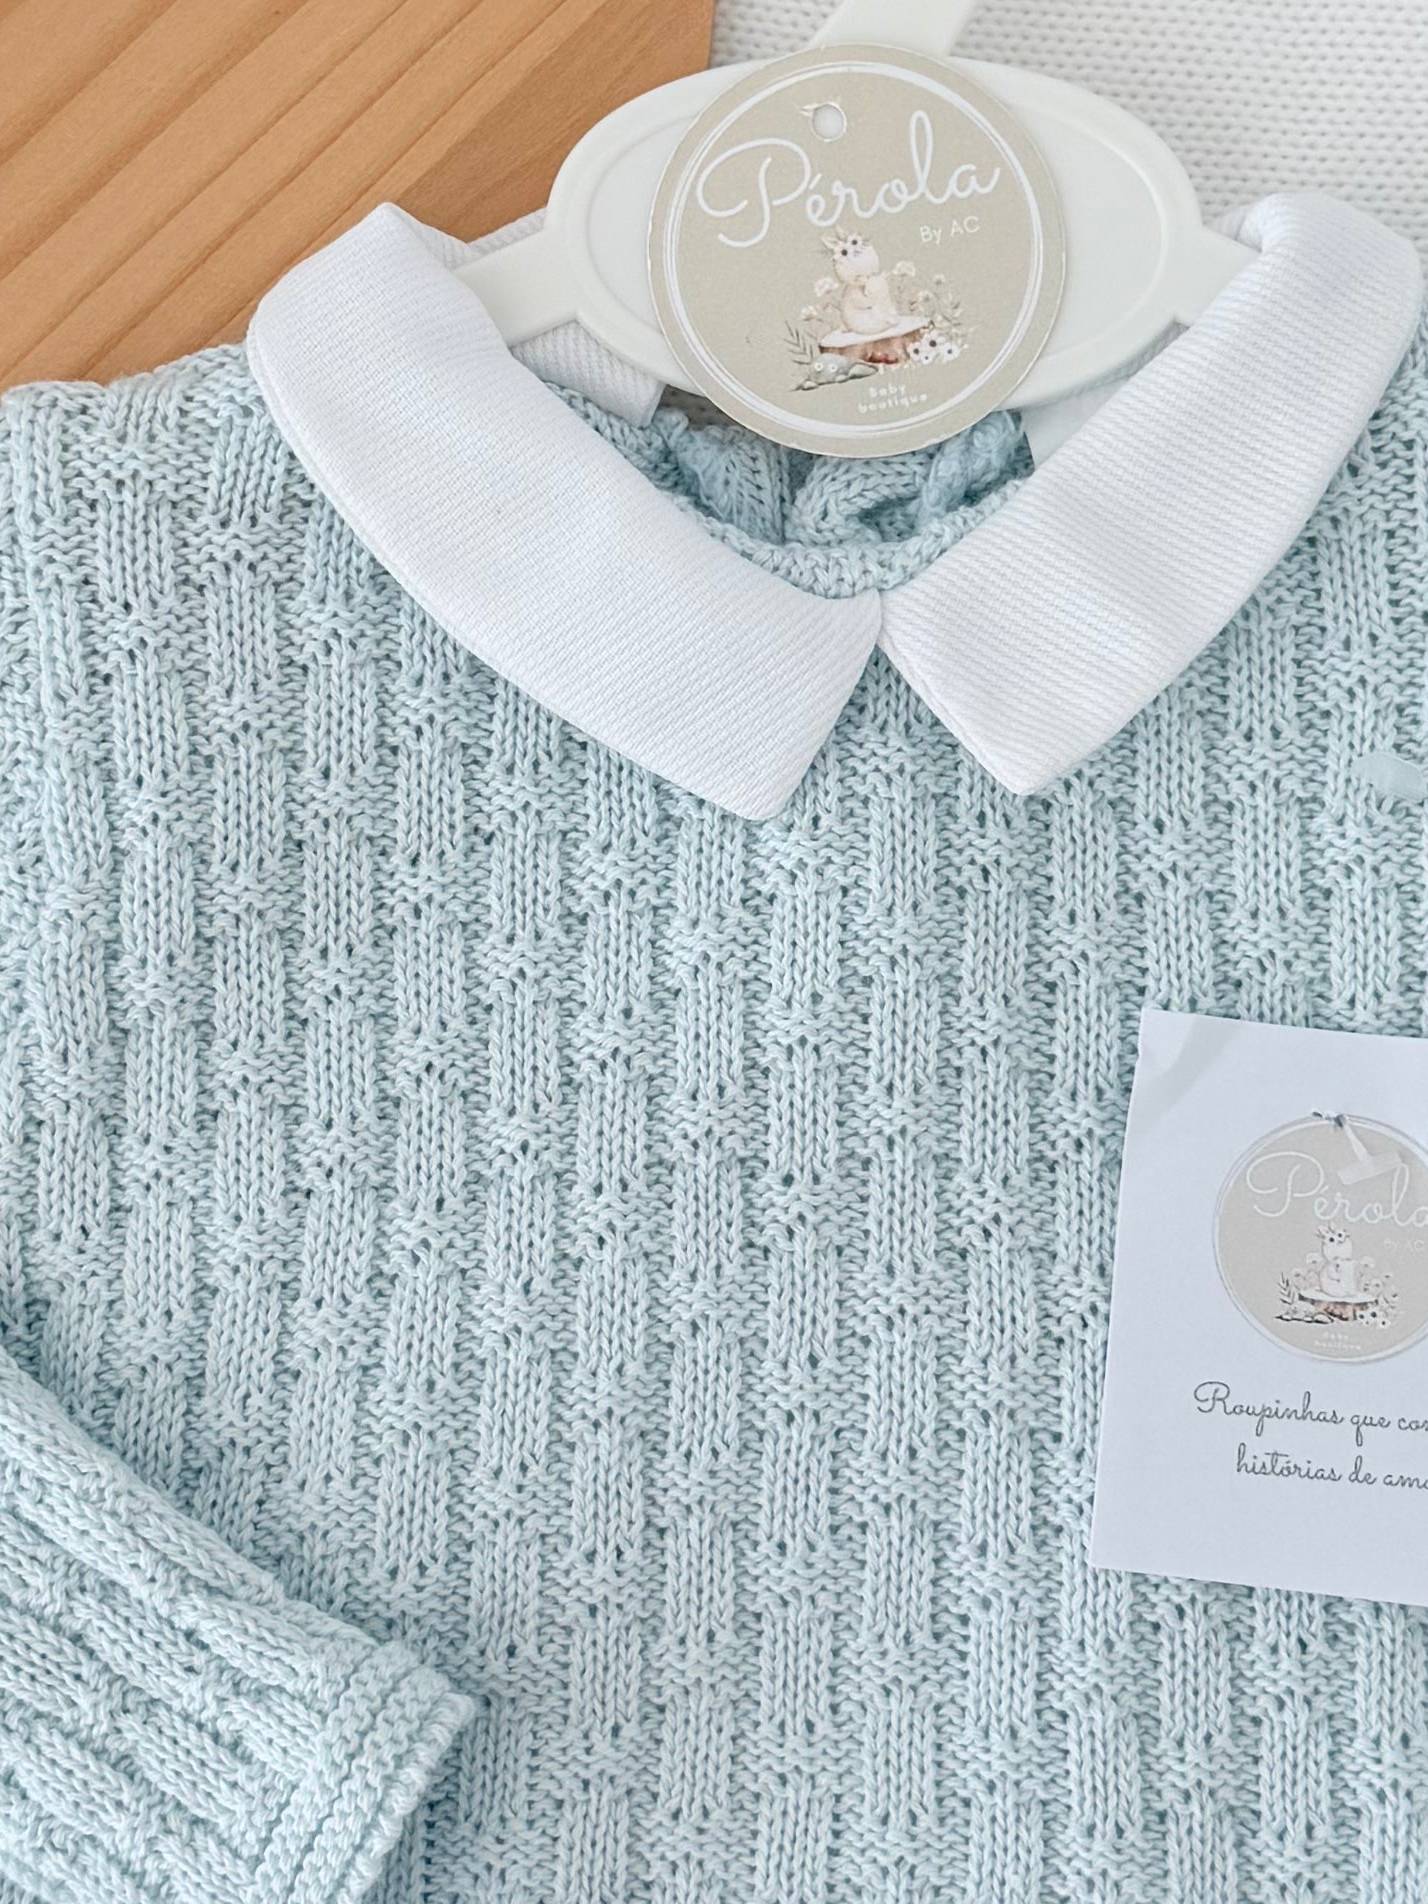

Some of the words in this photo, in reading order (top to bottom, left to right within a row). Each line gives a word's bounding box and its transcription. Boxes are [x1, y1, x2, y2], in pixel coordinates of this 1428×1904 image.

[696, 109, 1002, 248] Pérola
[919, 225, 942, 245] By
[950, 215, 981, 237] AC
[1193, 1380, 1345, 1437] Roupinhas
[1350, 1412, 1391, 1447] que
[1236, 1442, 1342, 1482] histórias
[1348, 1454, 1377, 1485] de
